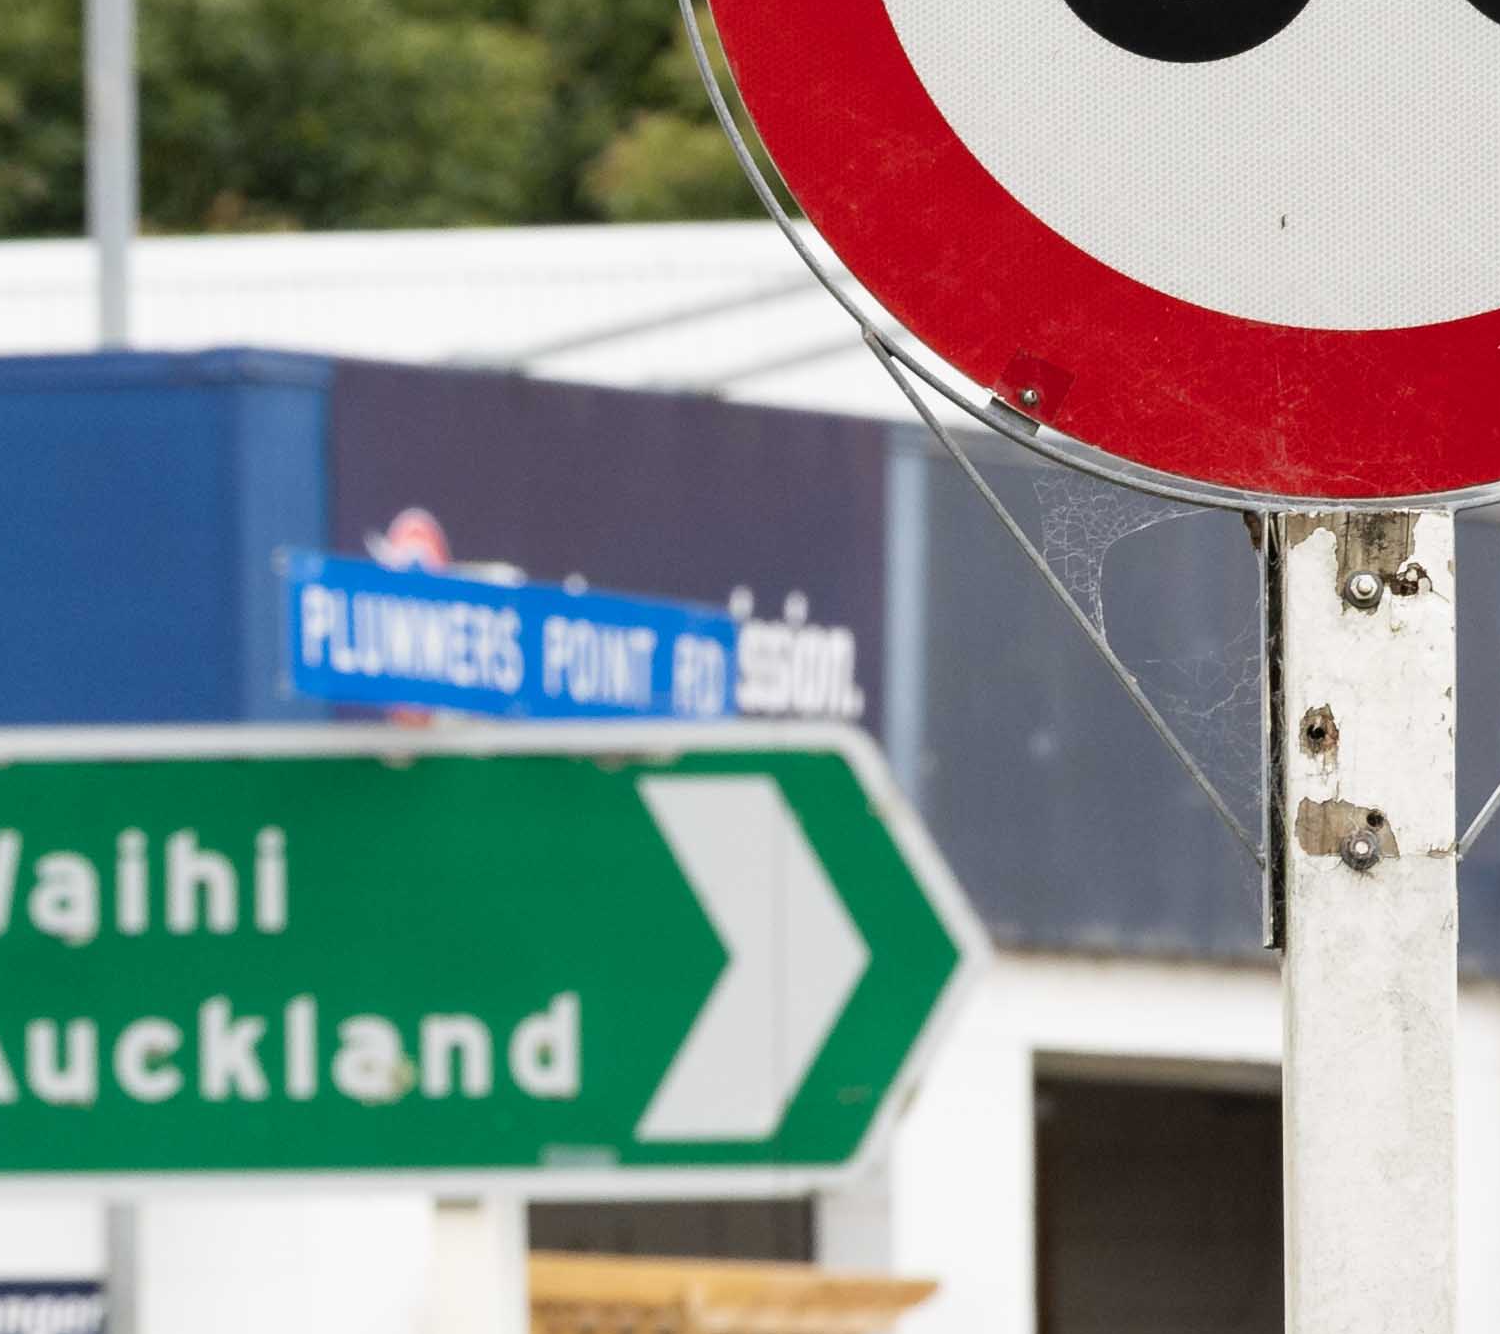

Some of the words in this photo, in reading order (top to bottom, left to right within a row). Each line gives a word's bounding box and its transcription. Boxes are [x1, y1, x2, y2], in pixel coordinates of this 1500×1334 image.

[301, 584, 525, 694] PLUMMERS
[542, 616, 657, 708] POINT
[671, 633, 727, 714] RD
